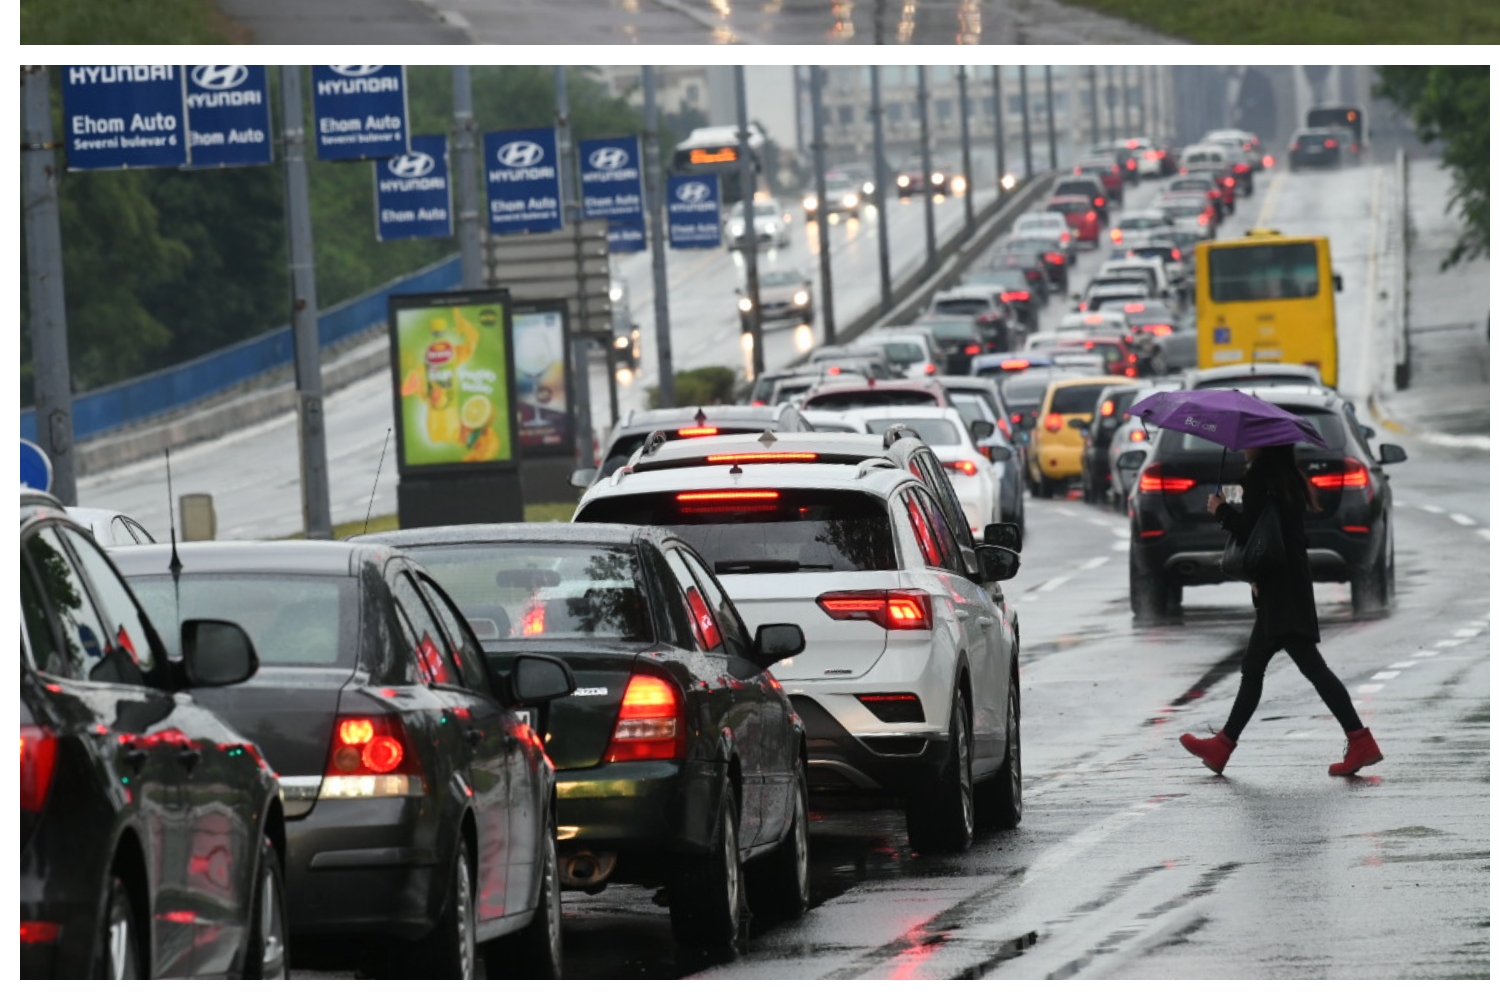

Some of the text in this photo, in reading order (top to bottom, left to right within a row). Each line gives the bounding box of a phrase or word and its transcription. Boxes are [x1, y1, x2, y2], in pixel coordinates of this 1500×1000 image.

[70, 65, 173, 85] HYUNDAI
[318, 77, 399, 96] HYUNDAI
[73, 113, 176, 134] Ehom Auto
[320, 115, 401, 133] Ehom Auto
[74, 134, 177, 150] Severni bulevar 6
[228, 128, 264, 145] Auto
[489, 166, 555, 183] HYUNDAI
[380, 176, 445, 193] HYUNDAI
[381, 207, 447, 223] Ehom Auto
